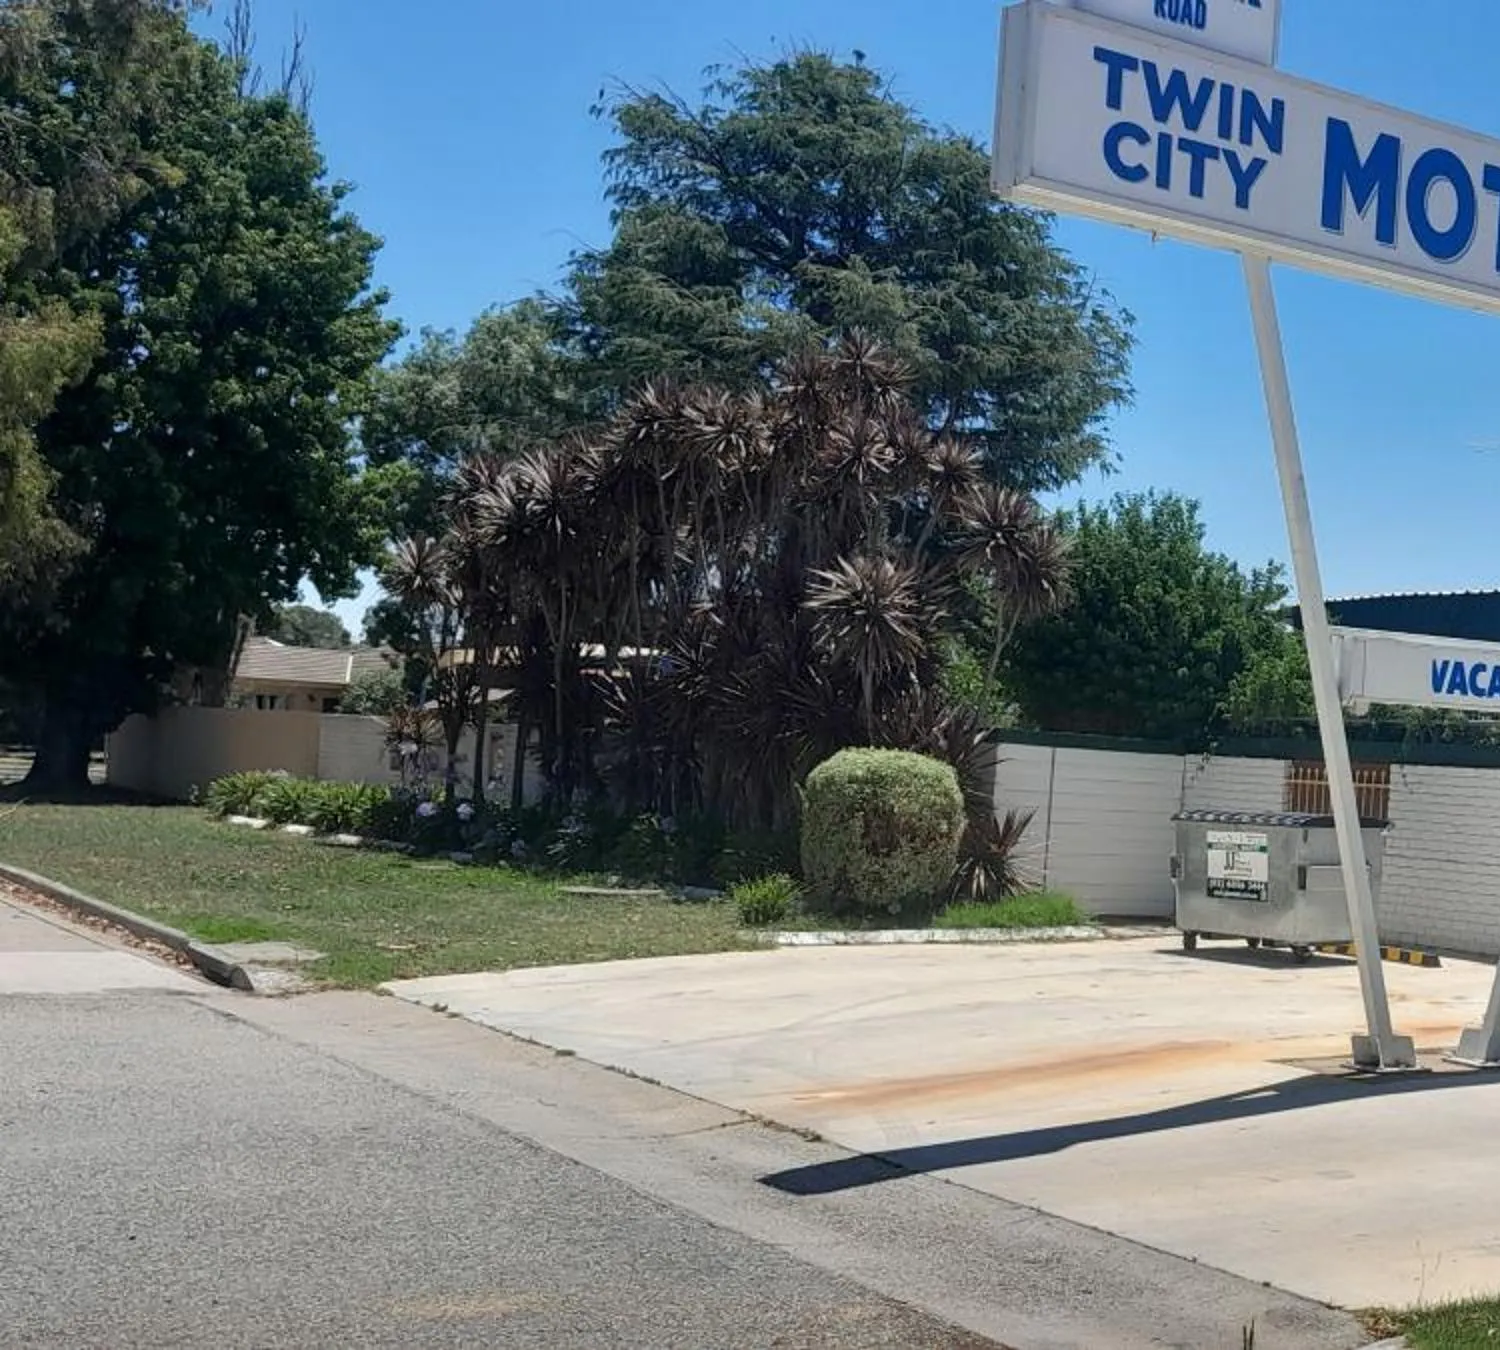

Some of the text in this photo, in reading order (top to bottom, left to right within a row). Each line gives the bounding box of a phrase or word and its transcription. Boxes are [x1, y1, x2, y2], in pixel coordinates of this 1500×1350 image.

[1154, 0, 1206, 29] ROAD
[1093, 46, 1284, 155] TWIN
[1103, 121, 1267, 210] CITY
